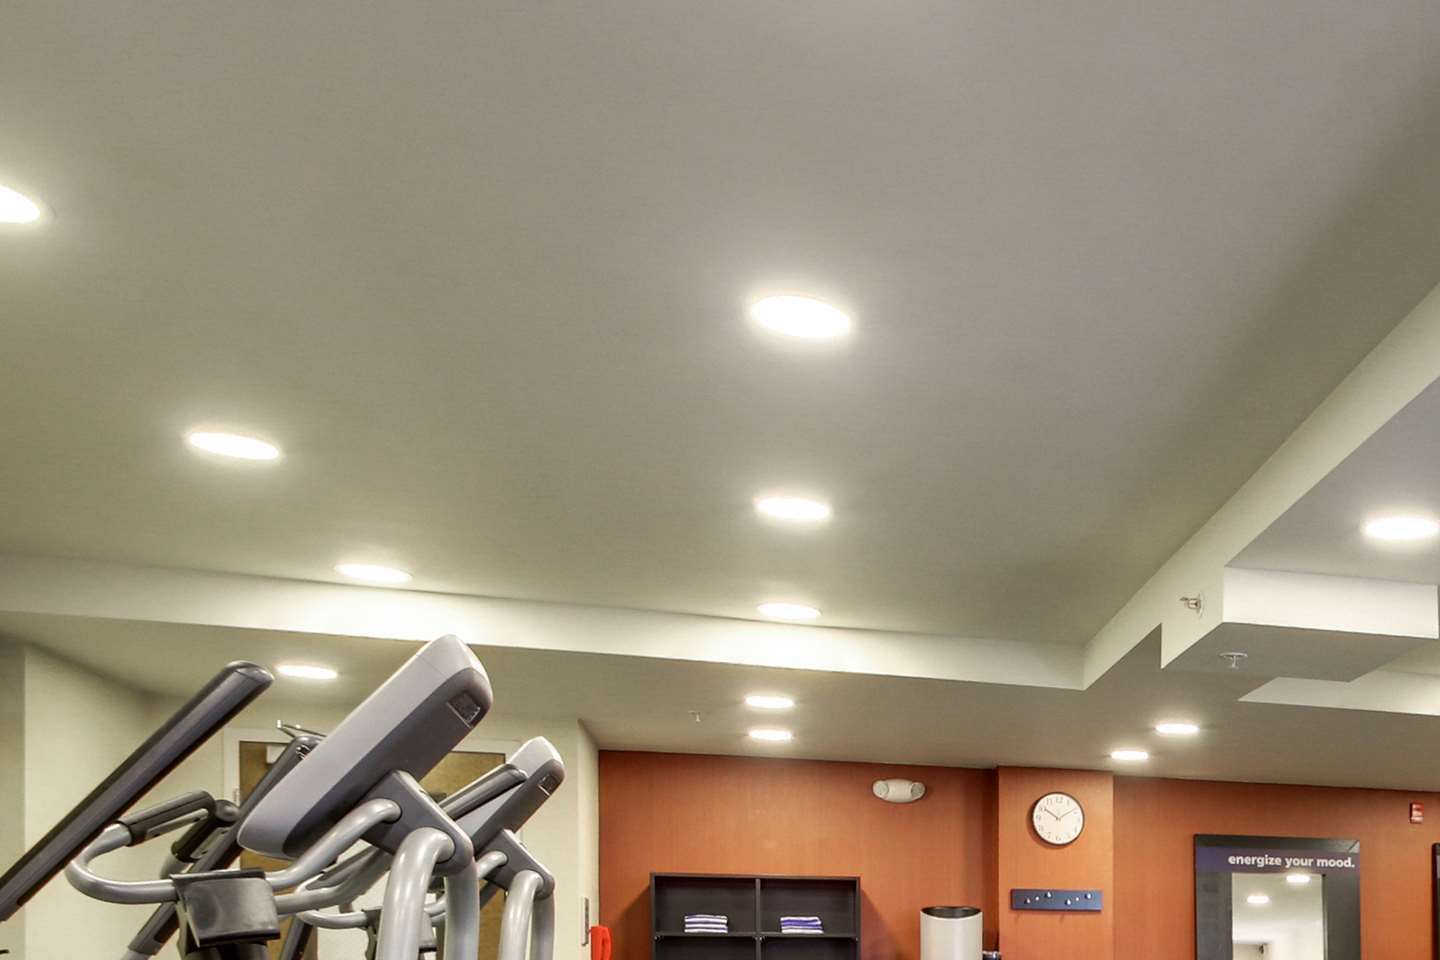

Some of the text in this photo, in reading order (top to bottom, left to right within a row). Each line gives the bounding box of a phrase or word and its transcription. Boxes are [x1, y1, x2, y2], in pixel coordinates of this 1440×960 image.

[1228, 854, 1356, 869] energize your mood.
